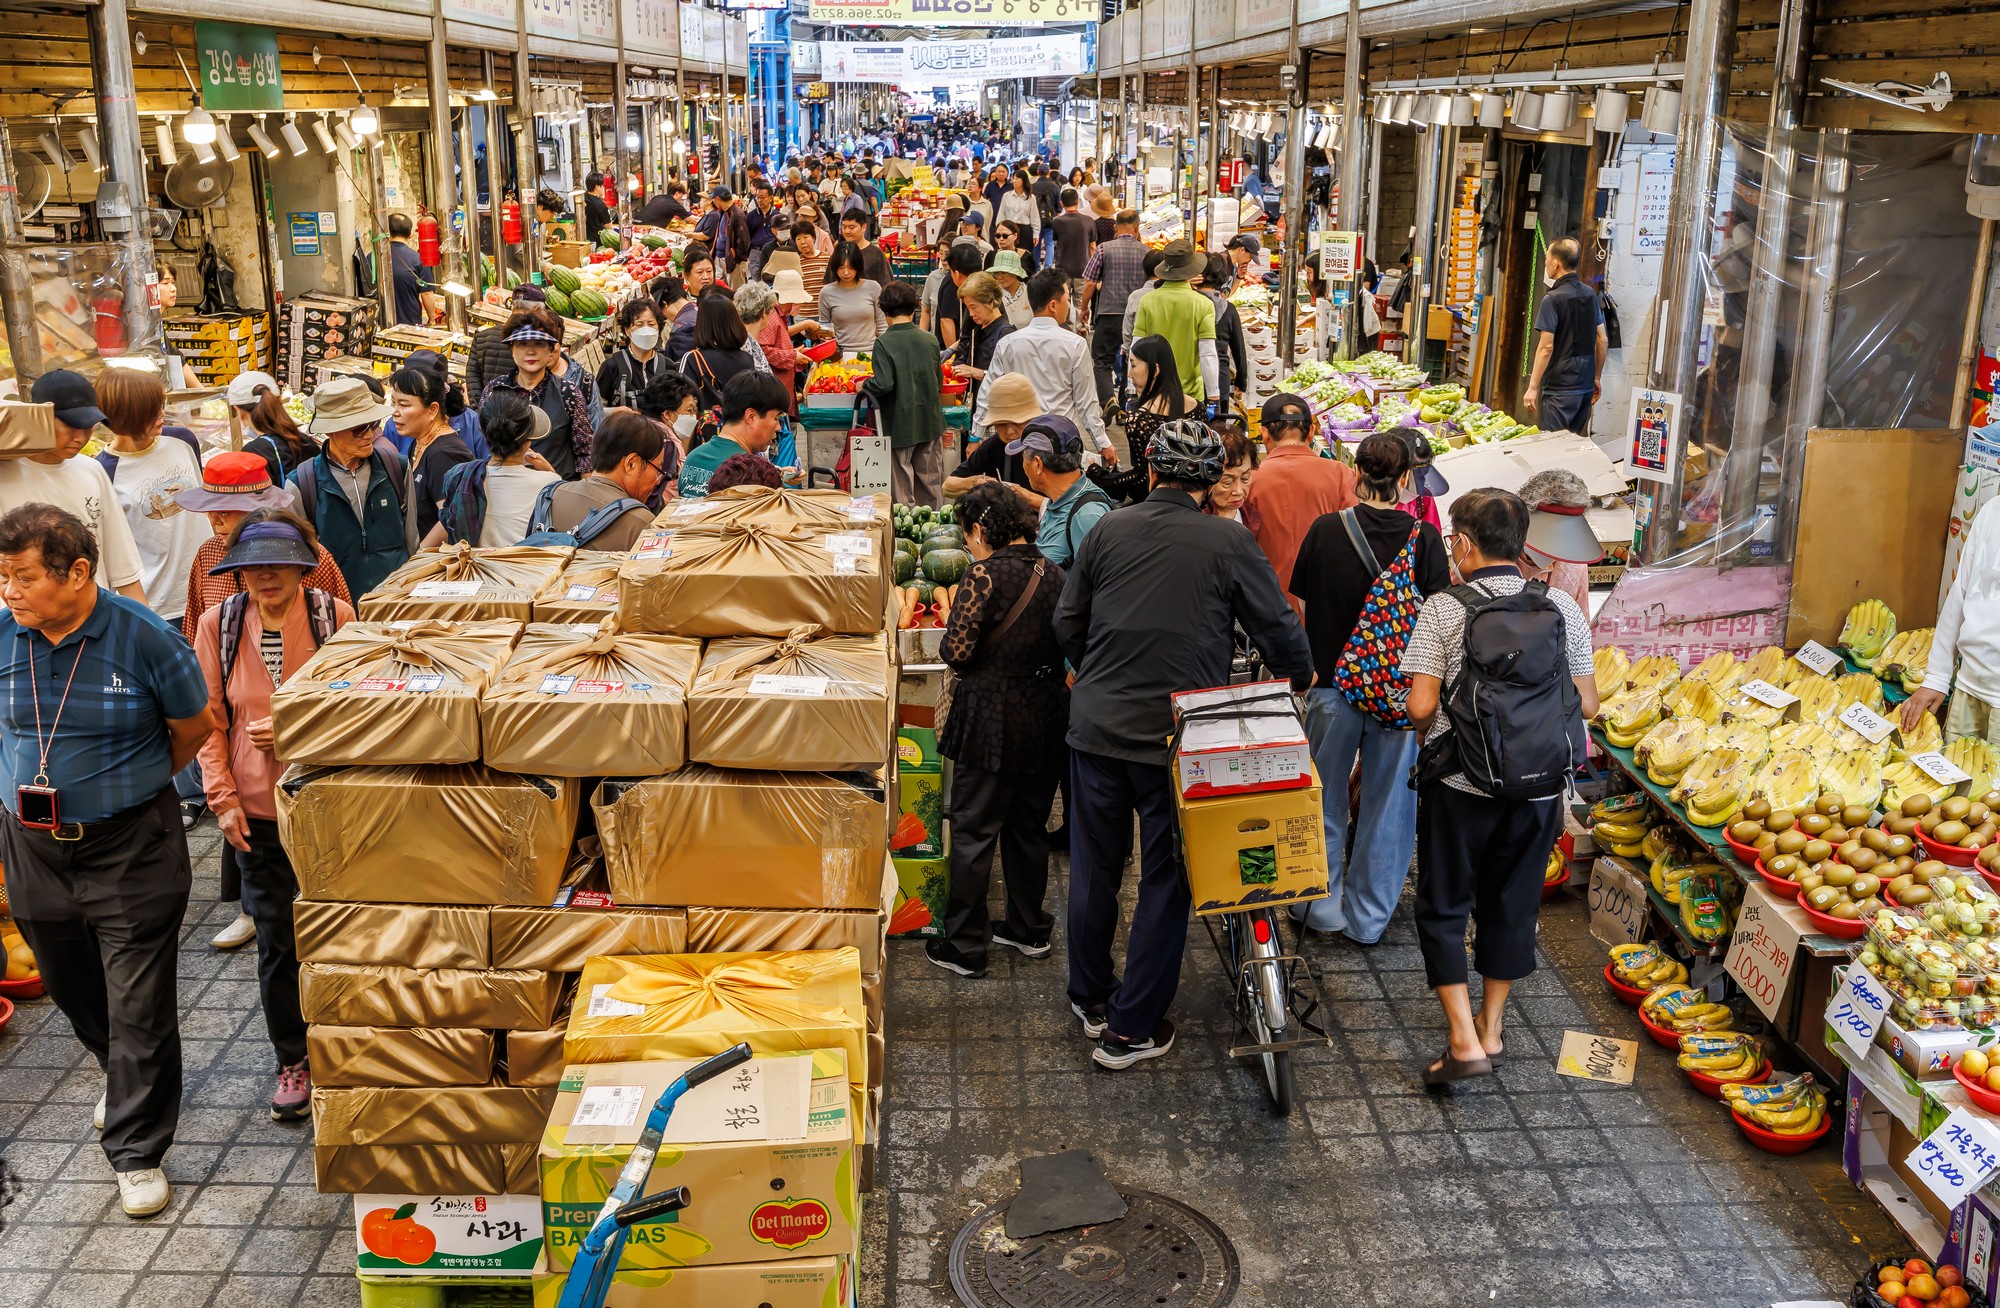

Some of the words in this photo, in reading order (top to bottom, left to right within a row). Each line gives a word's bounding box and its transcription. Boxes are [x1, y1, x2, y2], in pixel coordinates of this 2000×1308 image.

[205, 49, 236, 86] 강오
[253, 52, 278, 87] 상회
[1325, 247, 1350, 257] 환급행사
[1325, 258, 1349, 268] 참여점포
[1588, 614, 1684, 638] 리포니아
[1693, 614, 1758, 638] 체리와
[1747, 683, 1778, 699] 5.000
[1847, 708, 1877, 729] 5.000
[1918, 755, 1949, 775] 6.000
[1751, 923, 1789, 977] 골드키위
[1946, 1124, 1996, 1174] 가을자두
[467, 1220, 528, 1242] 사과
[756, 1216, 778, 1230] Del
[781, 1213, 825, 1228] Monte
[775, 1228, 805, 1239] Quality
